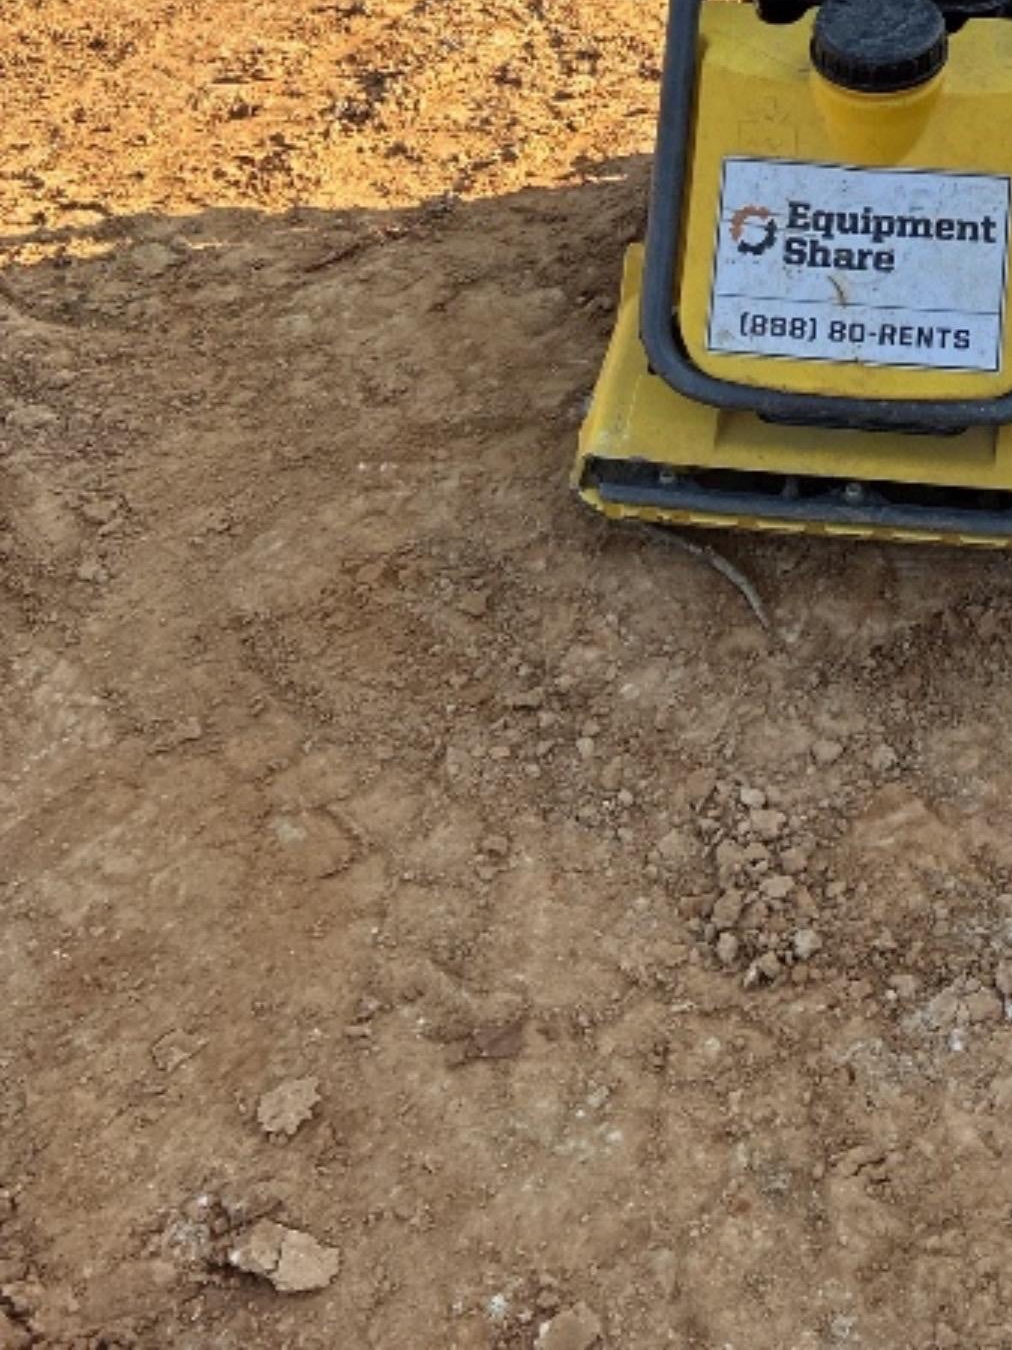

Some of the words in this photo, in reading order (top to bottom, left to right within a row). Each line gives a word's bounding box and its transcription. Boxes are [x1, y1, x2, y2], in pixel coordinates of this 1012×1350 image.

[786, 201, 997, 244] Equipment
[782, 237, 895, 273] Share
[739, 311, 818, 342] (888)
[827, 320, 971, 350] 80-RENTS
